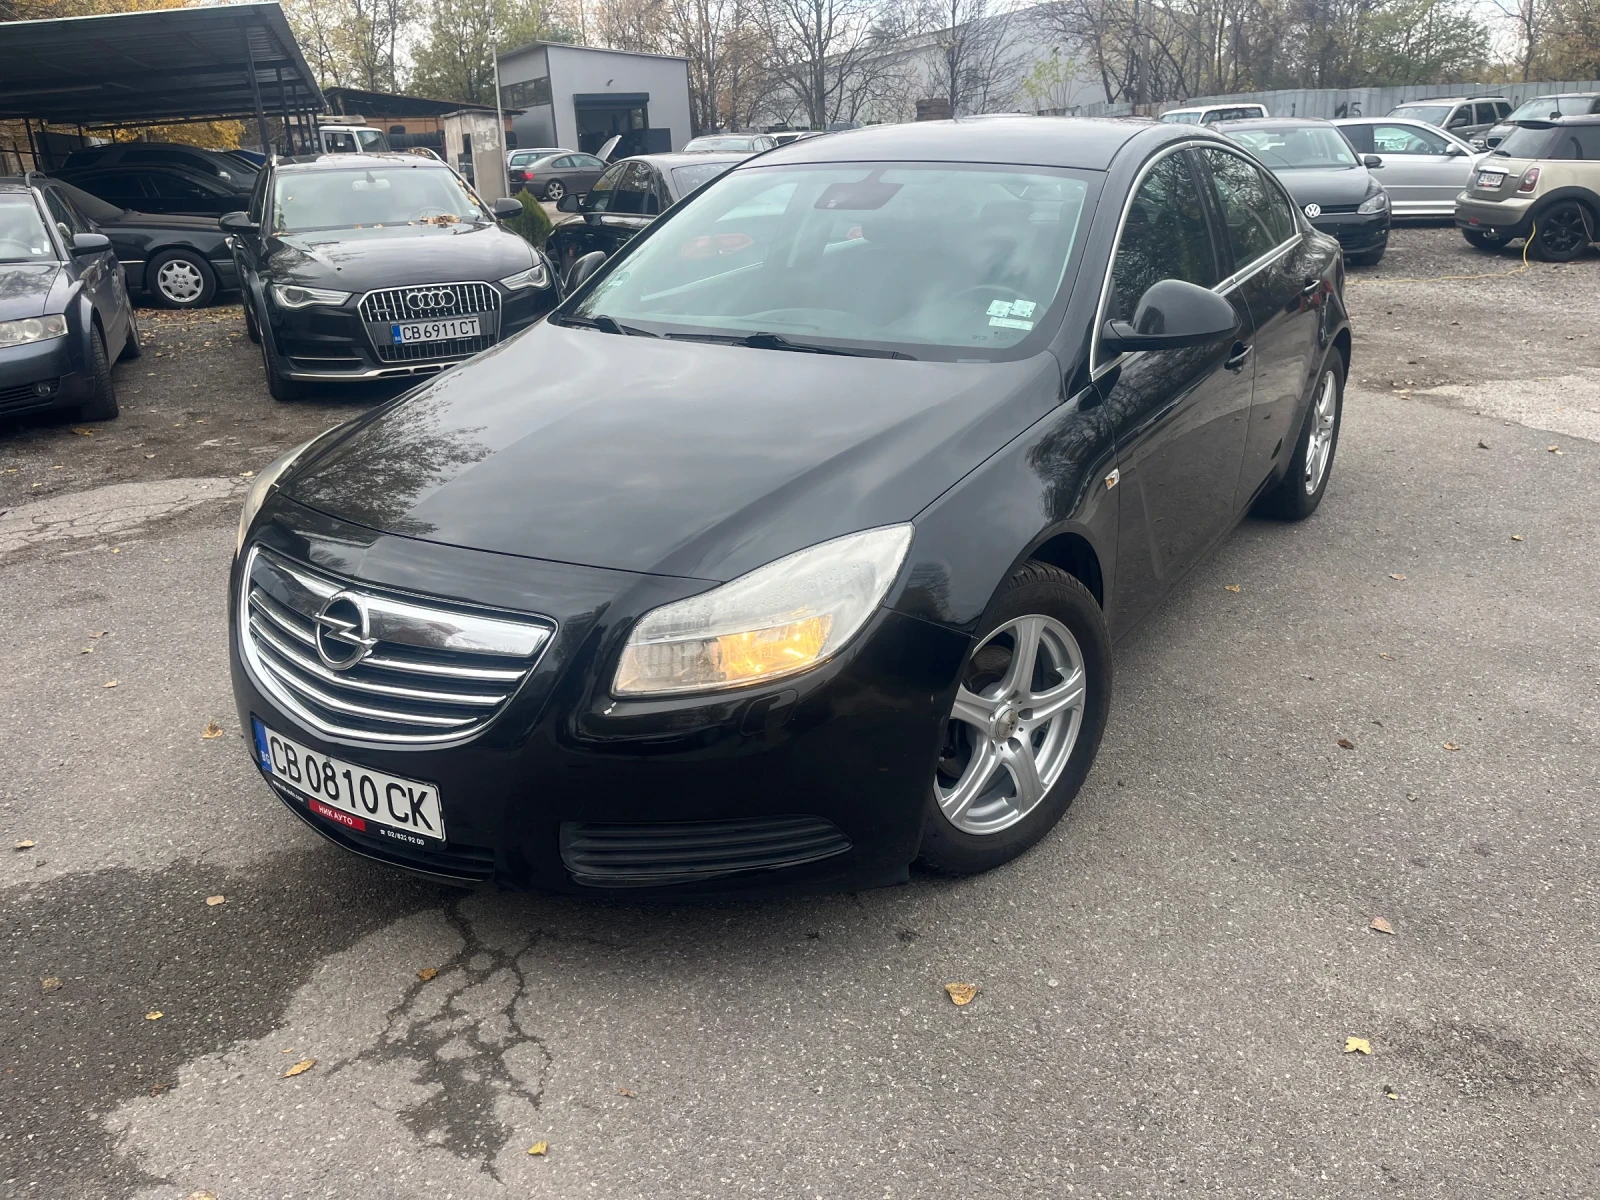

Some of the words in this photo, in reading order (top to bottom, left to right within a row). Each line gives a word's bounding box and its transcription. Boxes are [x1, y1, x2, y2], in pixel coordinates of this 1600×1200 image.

[402, 325, 421, 341] CB
[424, 322, 457, 338] 6911
[460, 320, 477, 334] CT
[261, 751, 271, 765] BG
[270, 736, 302, 784] CB
[305, 754, 379, 815] 0810
[385, 782, 435, 832] CK
[318, 804, 334, 819] НИК
[333, 811, 353, 826] АУТО
